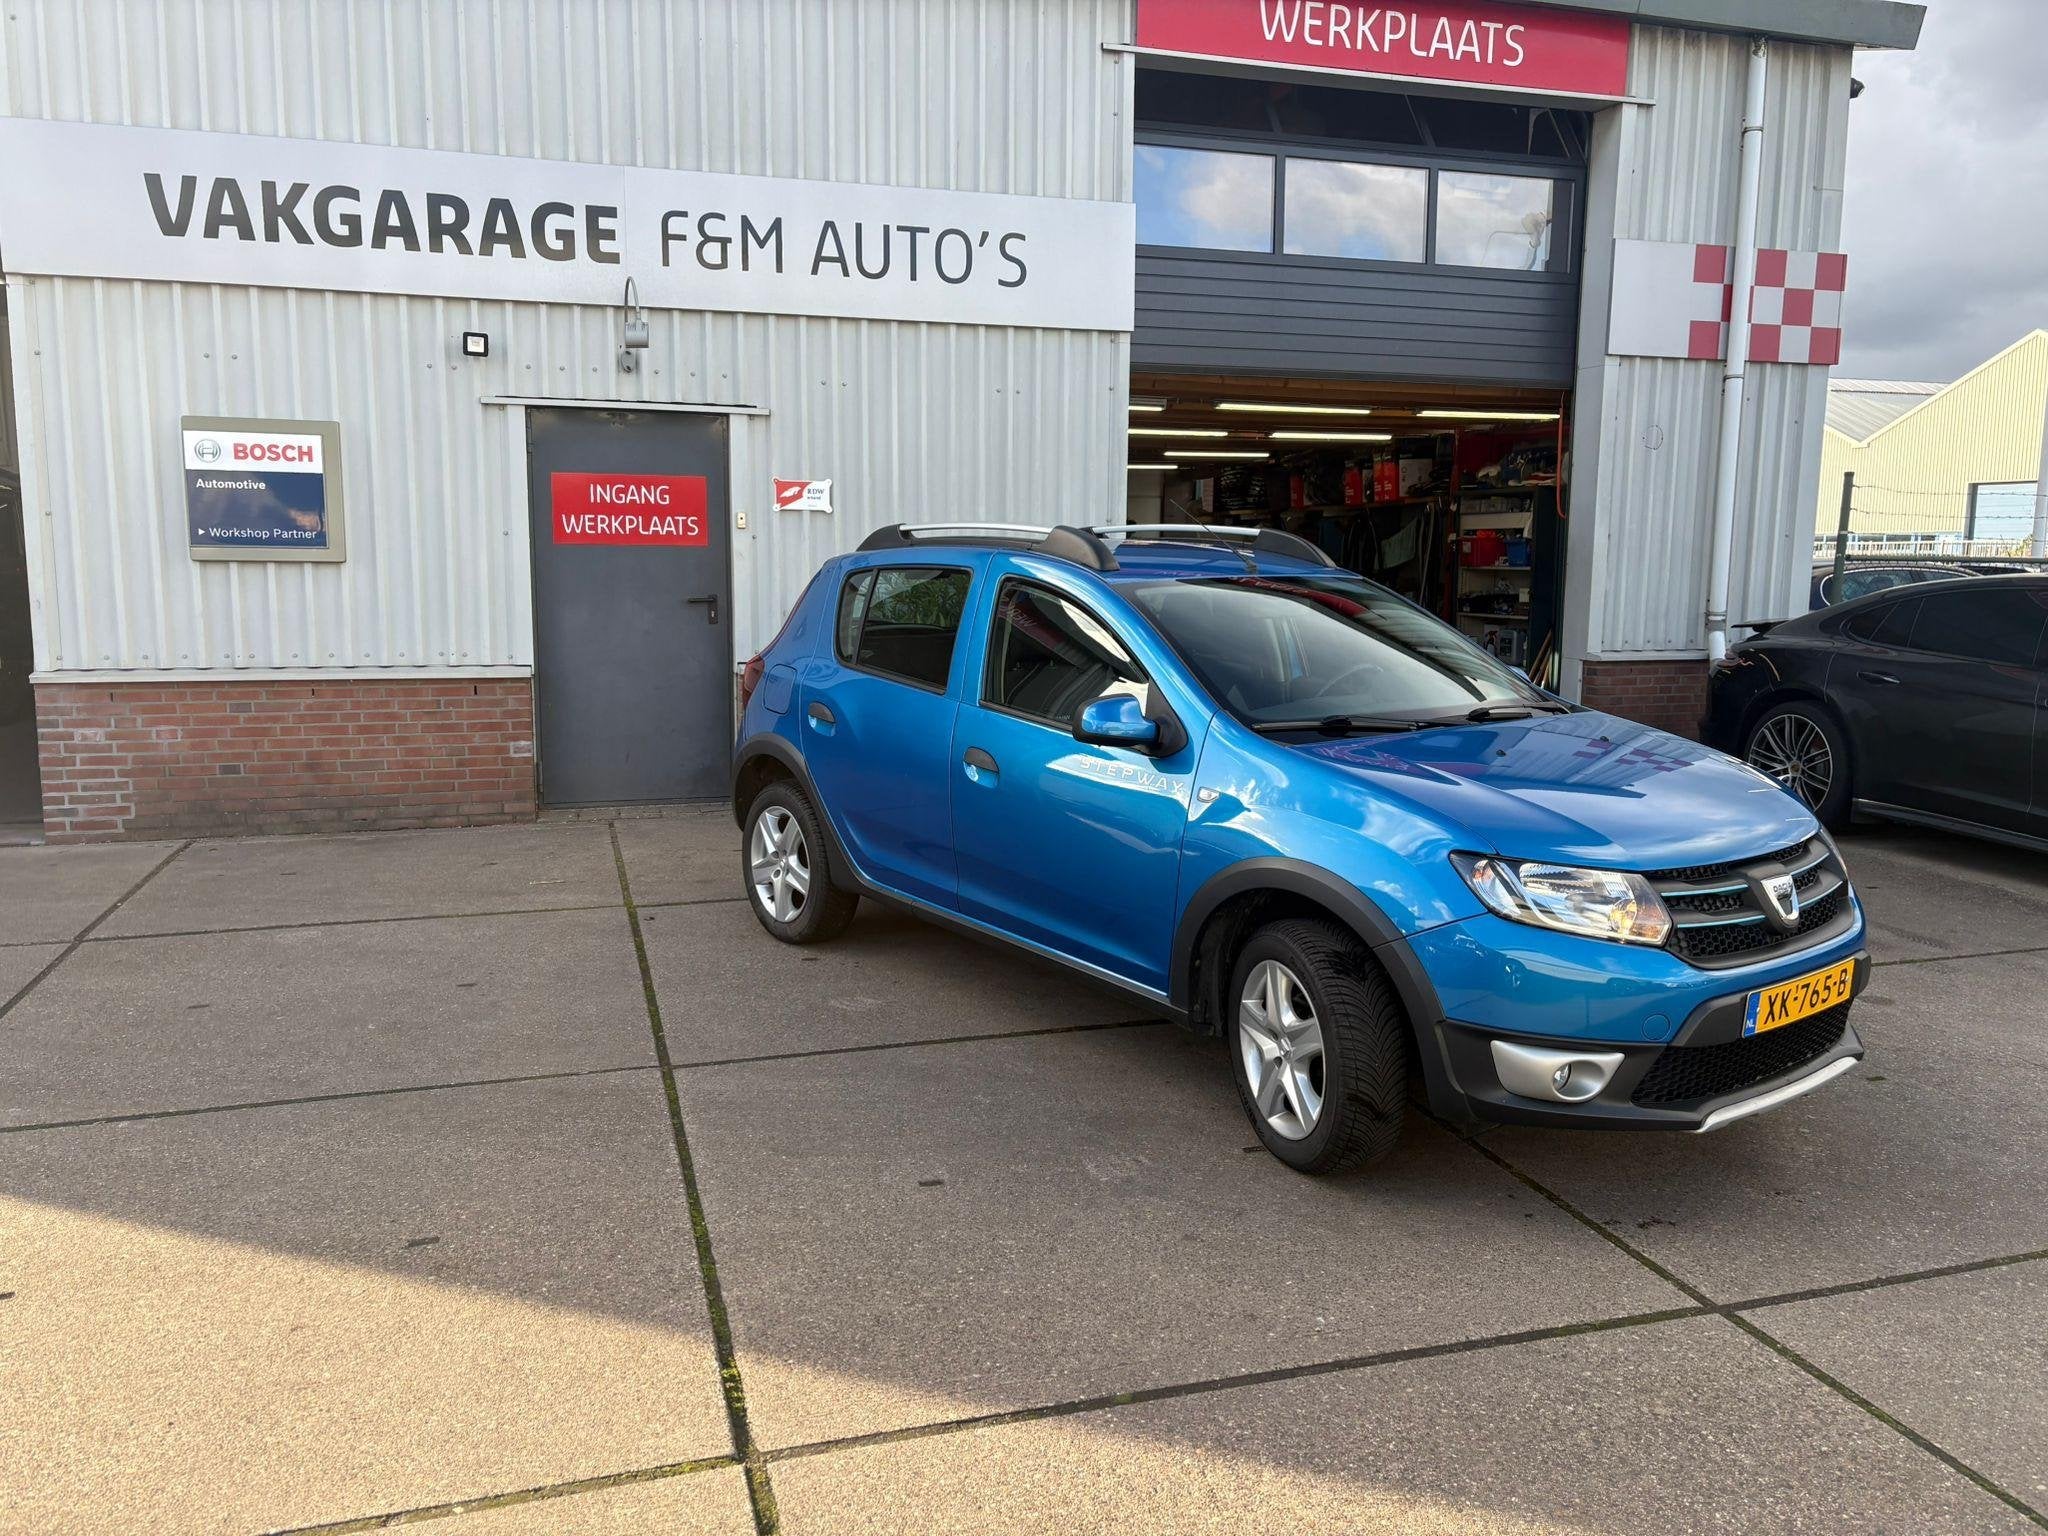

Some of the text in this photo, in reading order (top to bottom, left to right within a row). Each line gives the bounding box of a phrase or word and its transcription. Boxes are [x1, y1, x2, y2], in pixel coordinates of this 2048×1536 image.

[1259, 0, 1526, 67] WERKPLAATS
[143, 172, 1028, 289] VAKGARAGE F&M AUTO'S
[232, 442, 314, 463] BOSCH
[196, 478, 266, 490] Automotive
[589, 483, 670, 505] INGANG
[208, 527, 318, 540] Workshop Partner
[561, 513, 699, 536] WERKPLAATS
[1079, 755, 1184, 794] STEPWAY
[1763, 967, 1848, 1025] XK-765-B
